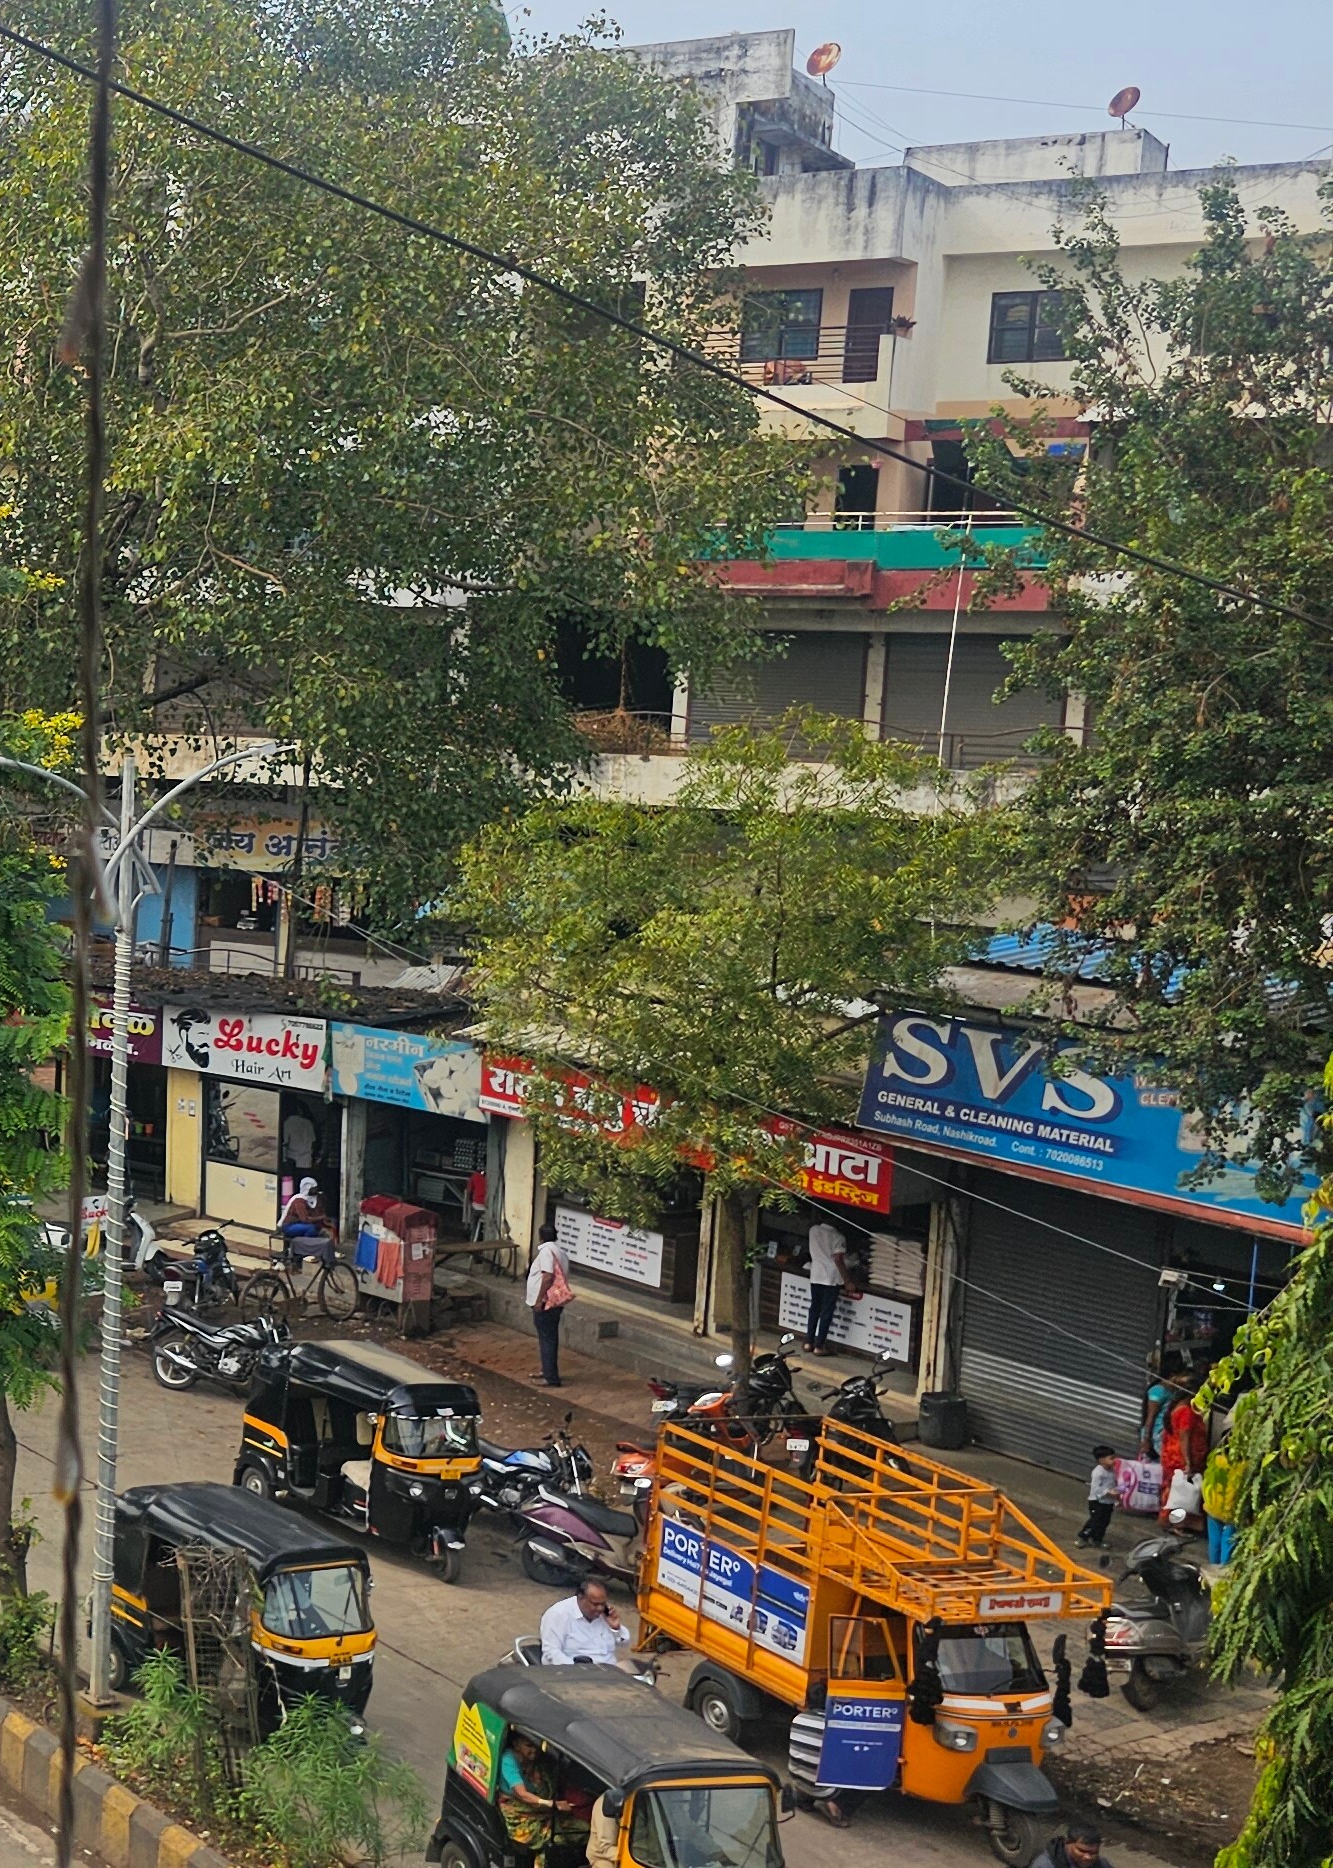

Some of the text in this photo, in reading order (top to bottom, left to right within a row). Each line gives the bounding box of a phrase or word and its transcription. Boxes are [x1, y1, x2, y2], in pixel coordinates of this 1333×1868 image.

[213, 1018, 318, 1069] Lucky
[233, 1058, 292, 1082] Hair Art
[883, 1017, 1115, 1119] SVS
[874, 1110, 913, 1132] Subhash
[914, 1119, 941, 1136] Road,
[943, 1125, 997, 1148] Nashikroad.
[877, 1091, 1115, 1153] GENERAL & CLEANING MATERIAL
[833, 1702, 891, 1718] PORTER
